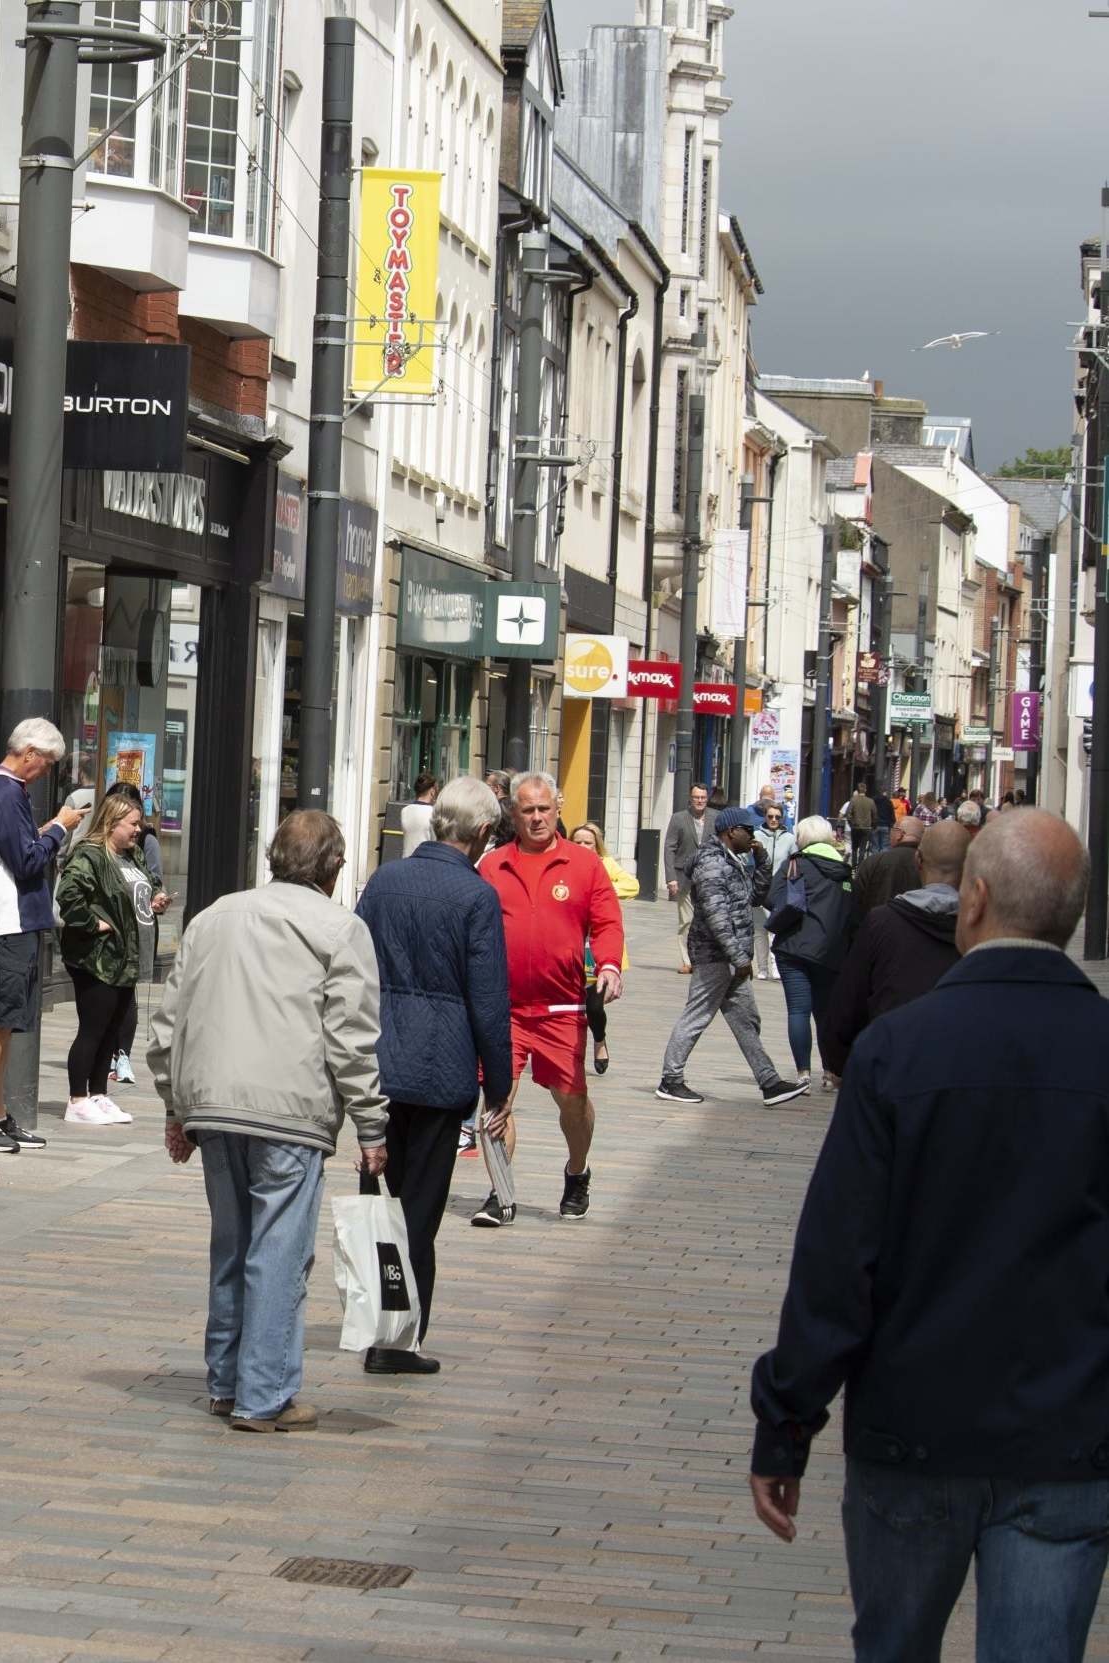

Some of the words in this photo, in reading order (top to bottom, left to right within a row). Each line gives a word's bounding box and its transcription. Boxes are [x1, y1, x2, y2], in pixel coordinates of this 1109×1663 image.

[64, 395, 172, 416] BURTON
[345, 510, 372, 568] home
[1020, 696, 1031, 740] GAME
